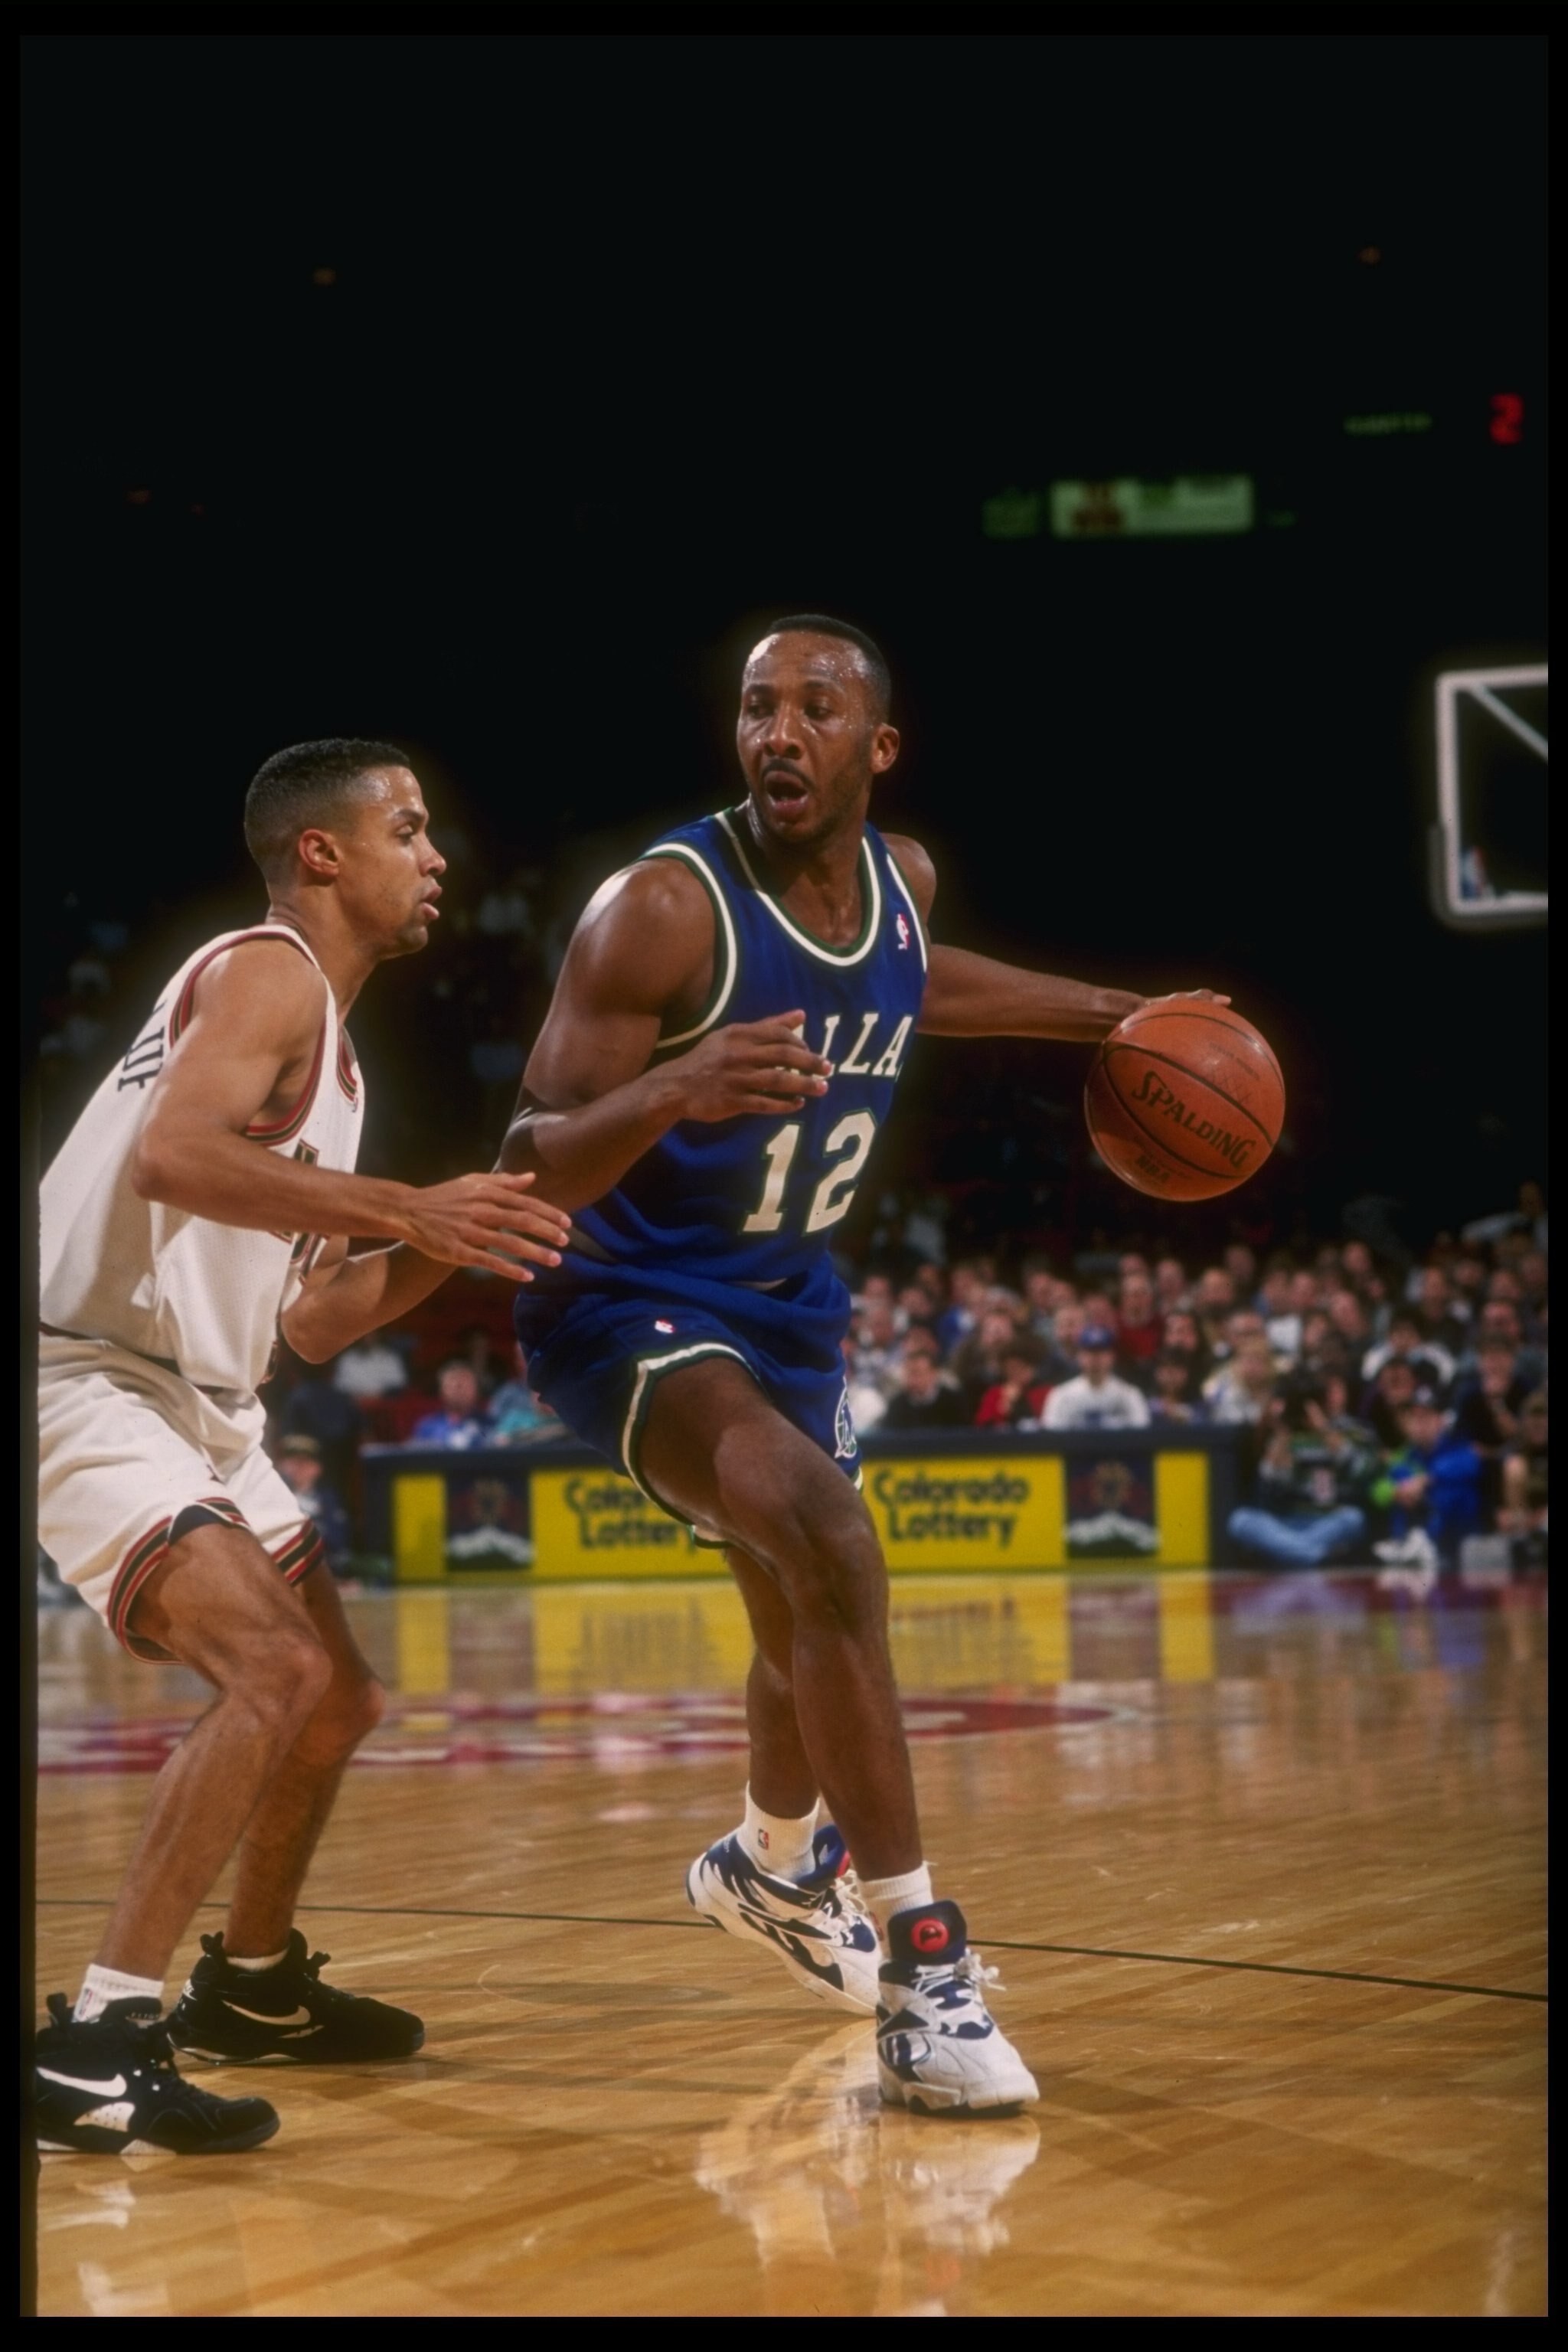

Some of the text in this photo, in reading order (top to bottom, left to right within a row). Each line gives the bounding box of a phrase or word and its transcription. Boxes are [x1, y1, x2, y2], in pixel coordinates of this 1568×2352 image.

[1490, 392, 1524, 445] 2
[1131, 1070, 1257, 1170] SPALDING
[741, 1109, 877, 1235] 12
[871, 1468, 1030, 1505] Colorado
[888, 1505, 1017, 1550] Lottery
